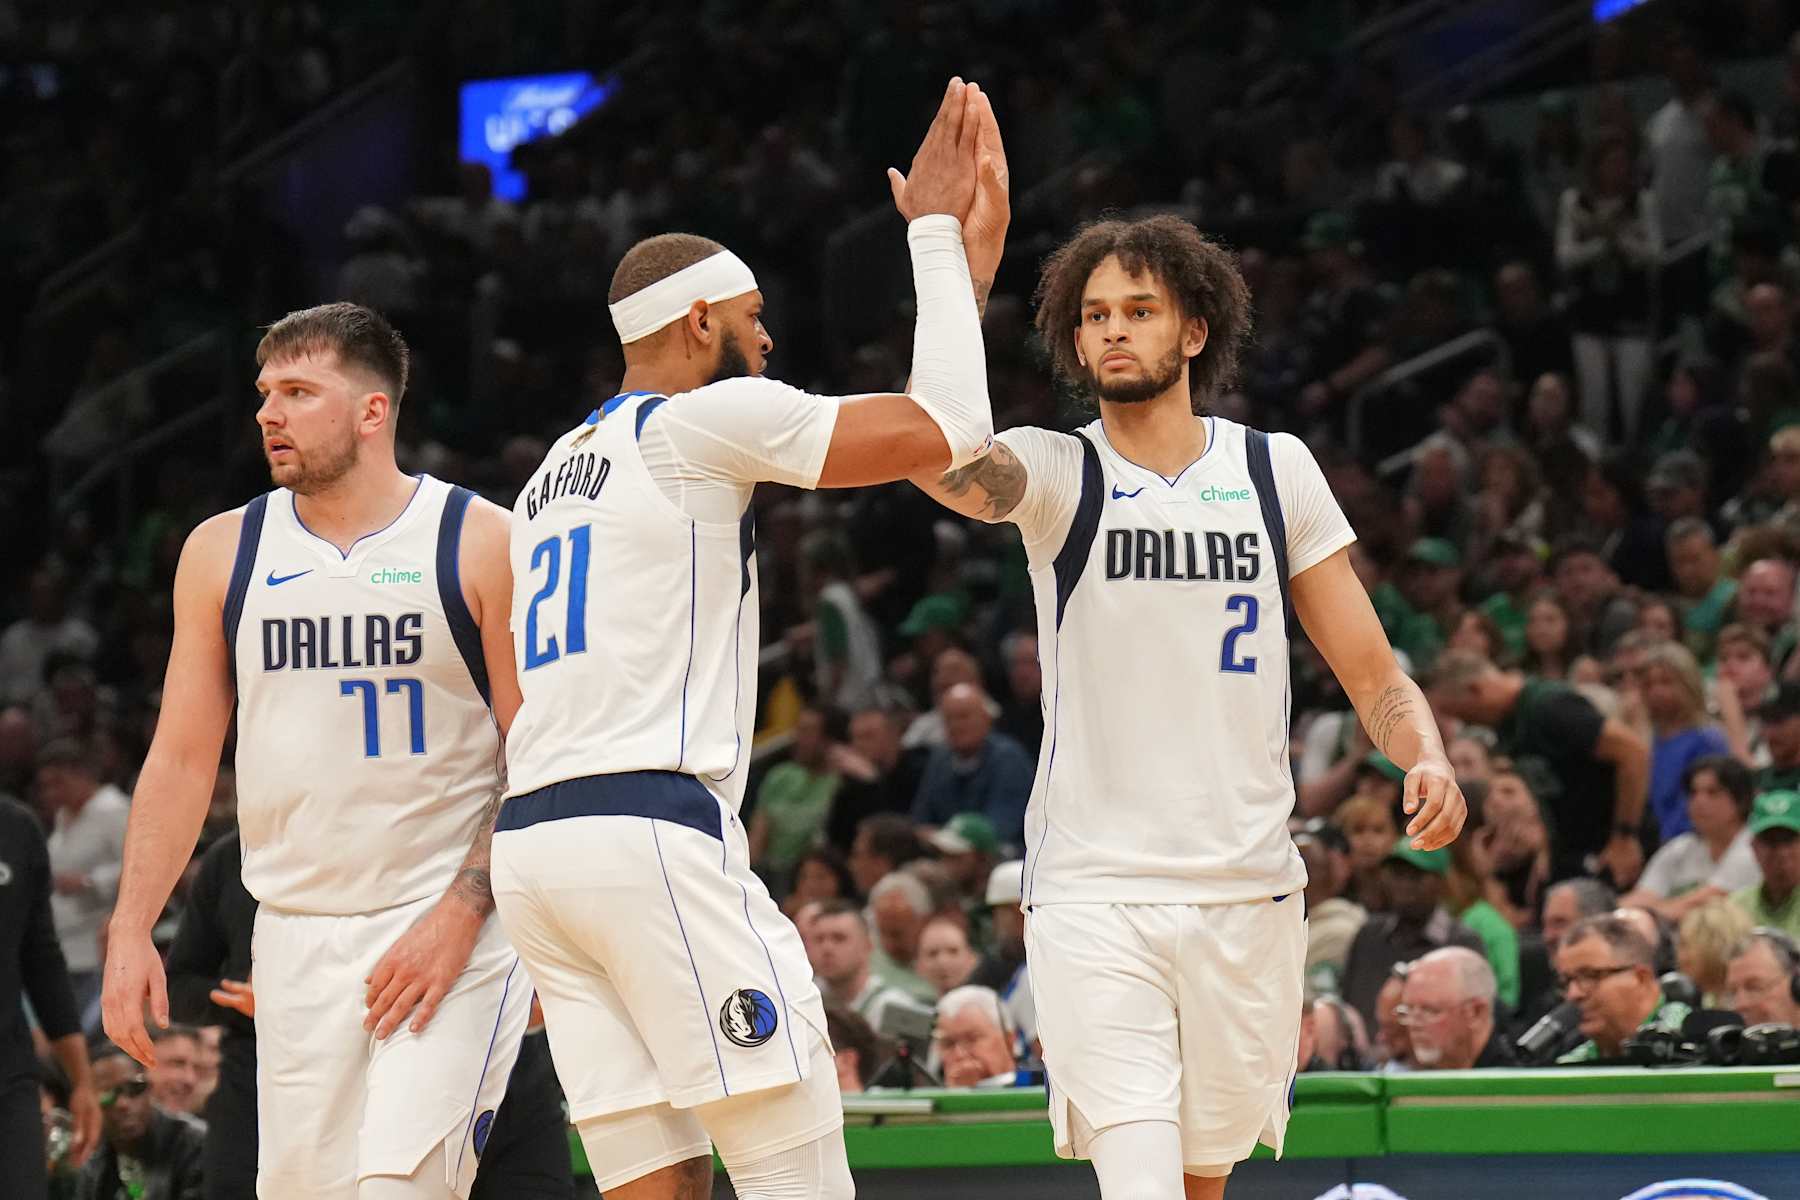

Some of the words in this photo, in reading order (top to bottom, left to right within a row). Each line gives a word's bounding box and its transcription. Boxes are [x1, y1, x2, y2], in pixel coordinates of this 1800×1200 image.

[526, 452, 611, 521] GAFFORD
[1200, 486, 1250, 502] chime
[371, 568, 422, 584] chime
[1105, 527, 1261, 584] DALLAS
[523, 523, 592, 673] 21
[262, 611, 425, 674] DALLAS
[1219, 593, 1260, 675] 2
[339, 677, 427, 759] 77
